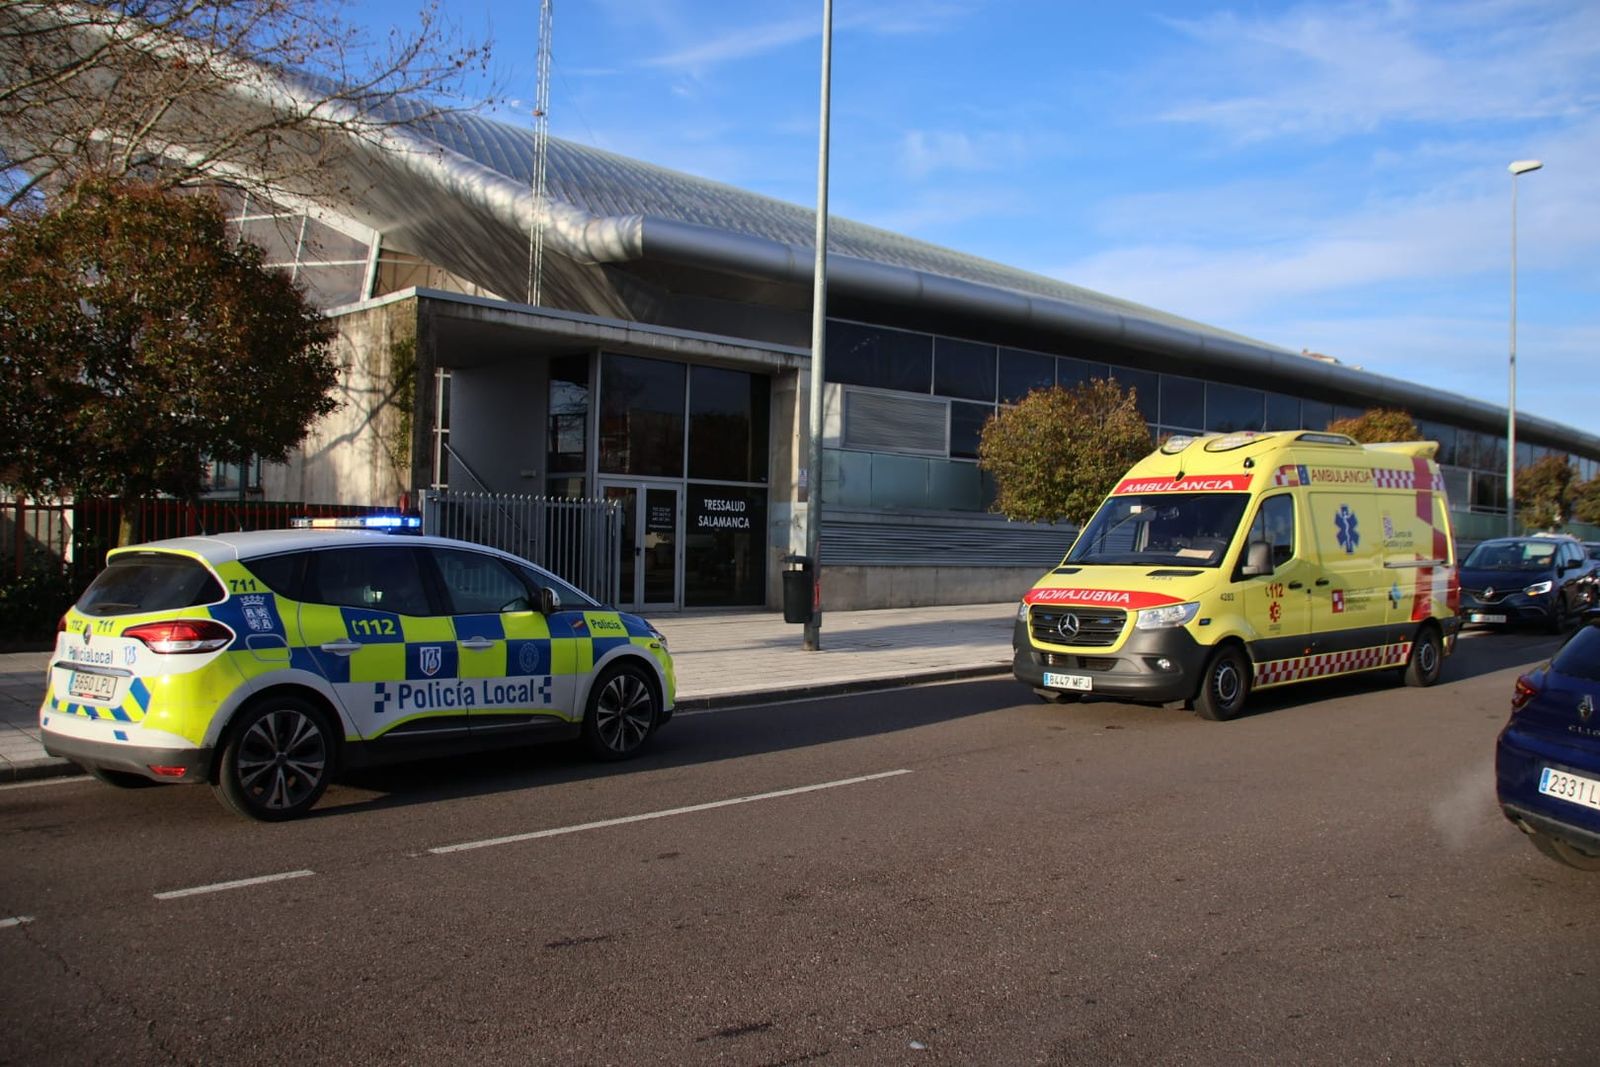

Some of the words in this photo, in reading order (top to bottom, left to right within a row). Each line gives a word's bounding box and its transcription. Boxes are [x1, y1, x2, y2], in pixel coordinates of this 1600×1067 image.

[1310, 469, 1373, 484] AMBULANCIA
[1122, 480, 1234, 493] AMBULANCIA
[703, 499, 746, 512] TRESSALUD
[698, 515, 750, 529] SALAMANCA
[229, 579, 257, 592] 711
[1269, 583, 1285, 598] 112
[72, 620, 83, 632] 112
[97, 620, 116, 633] 711
[358, 618, 397, 636] 112
[590, 618, 621, 631] Policía
[1050, 675, 1070, 686] 8447
[399, 680, 475, 709] Policía
[483, 679, 534, 704] Local
[1549, 774, 1585, 801] 2331
[1589, 784, 1600, 806] L
